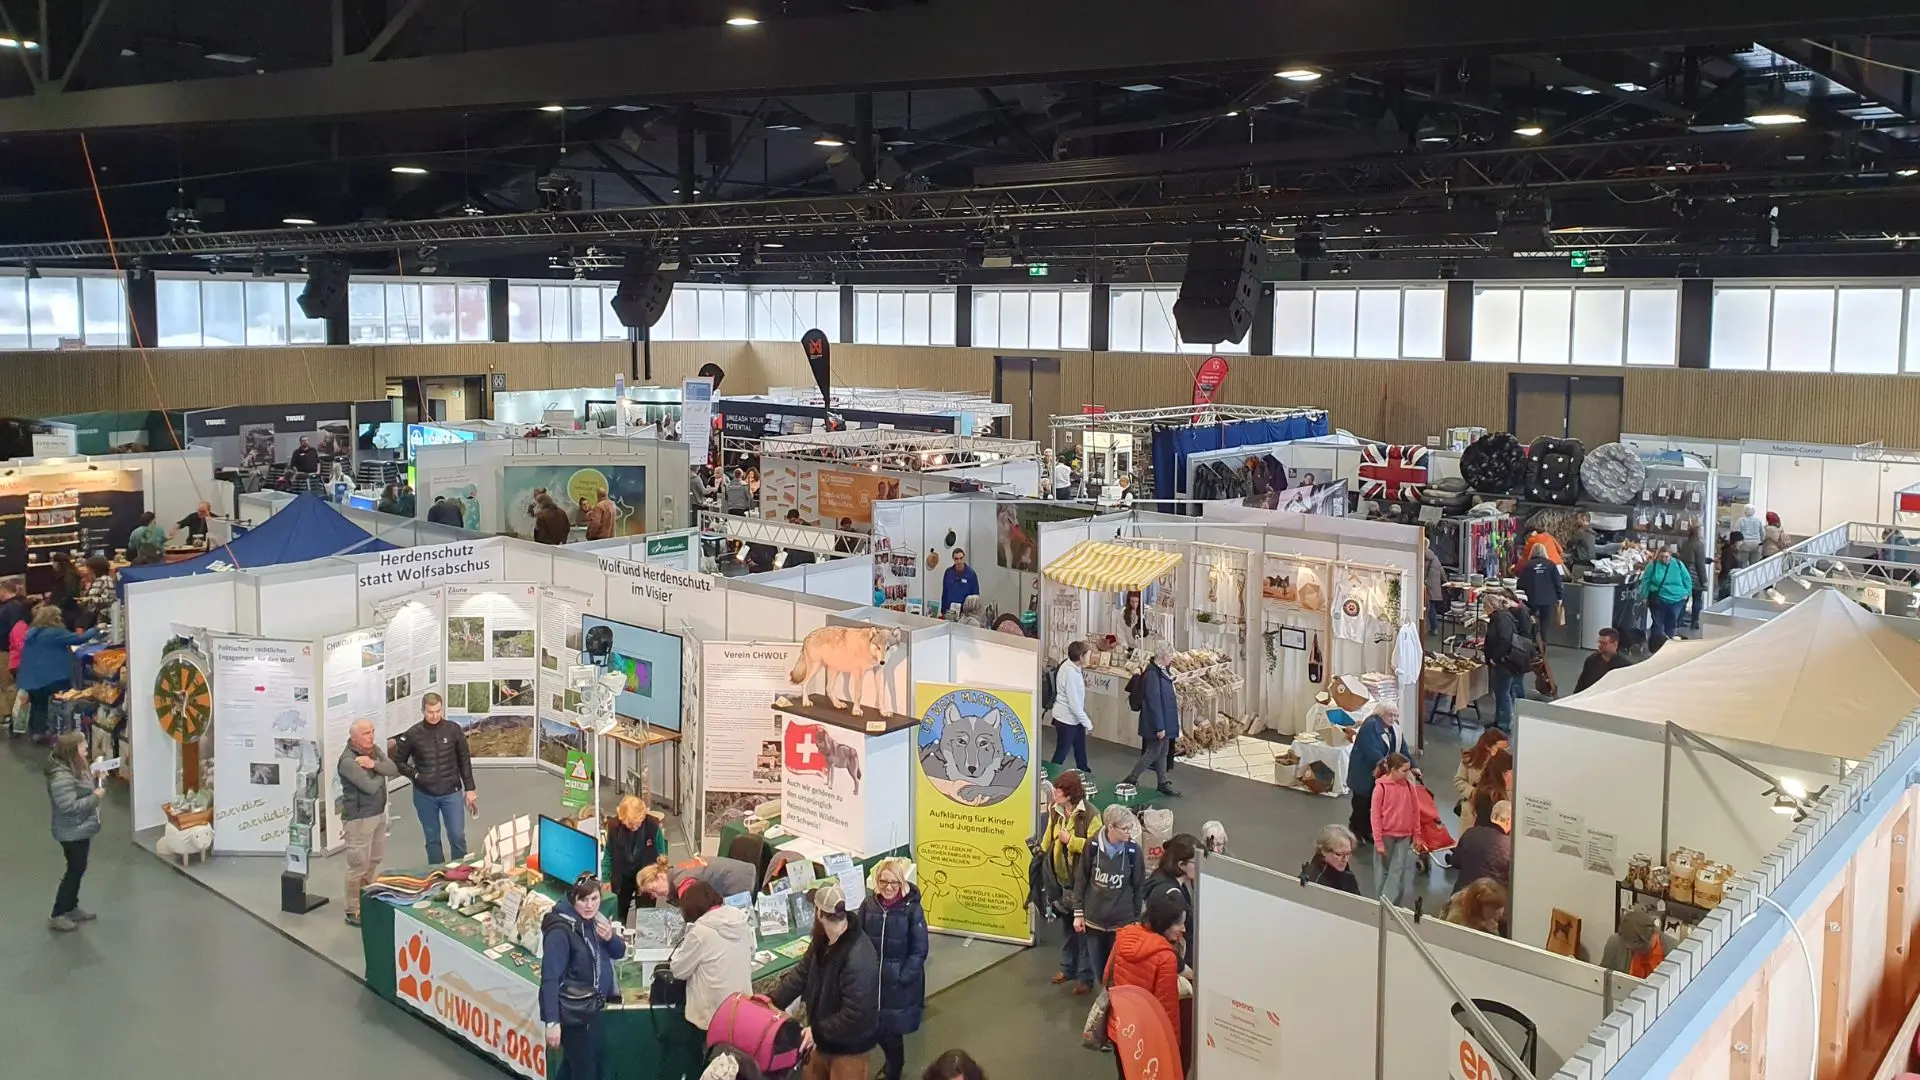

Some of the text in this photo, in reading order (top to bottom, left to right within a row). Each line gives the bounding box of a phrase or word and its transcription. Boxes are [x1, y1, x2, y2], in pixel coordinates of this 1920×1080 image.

[726, 414, 765, 424] UNLEASH YOUR
[726, 424, 751, 432] POTENTIAL
[380, 545, 474, 566] Herdenschutz
[360, 560, 490, 586] statt Wolfsabschus
[598, 558, 712, 592] Wolf und Herdenschutz
[632, 582, 673, 602] im Visier
[218, 644, 249, 653] Politisches
[254, 646, 287, 654] rechtliches
[218, 654, 254, 663] Engagement
[724, 650, 788, 660] Verein CHWOLF
[920, 692, 1026, 744] EIN WOLF MACHT SCHULE
[786, 778, 800, 788] Auch
[812, 788, 836, 800] gehören
[786, 790, 832, 810] den ursprünglich
[786, 800, 849, 828] heimischen Wildtieren
[786, 812, 796, 821] der
[929, 810, 1015, 826] Aufklärung für Kinder
[956, 824, 1005, 835] Jugendliche
[434, 985, 544, 1077] CHWOLF.ORG
